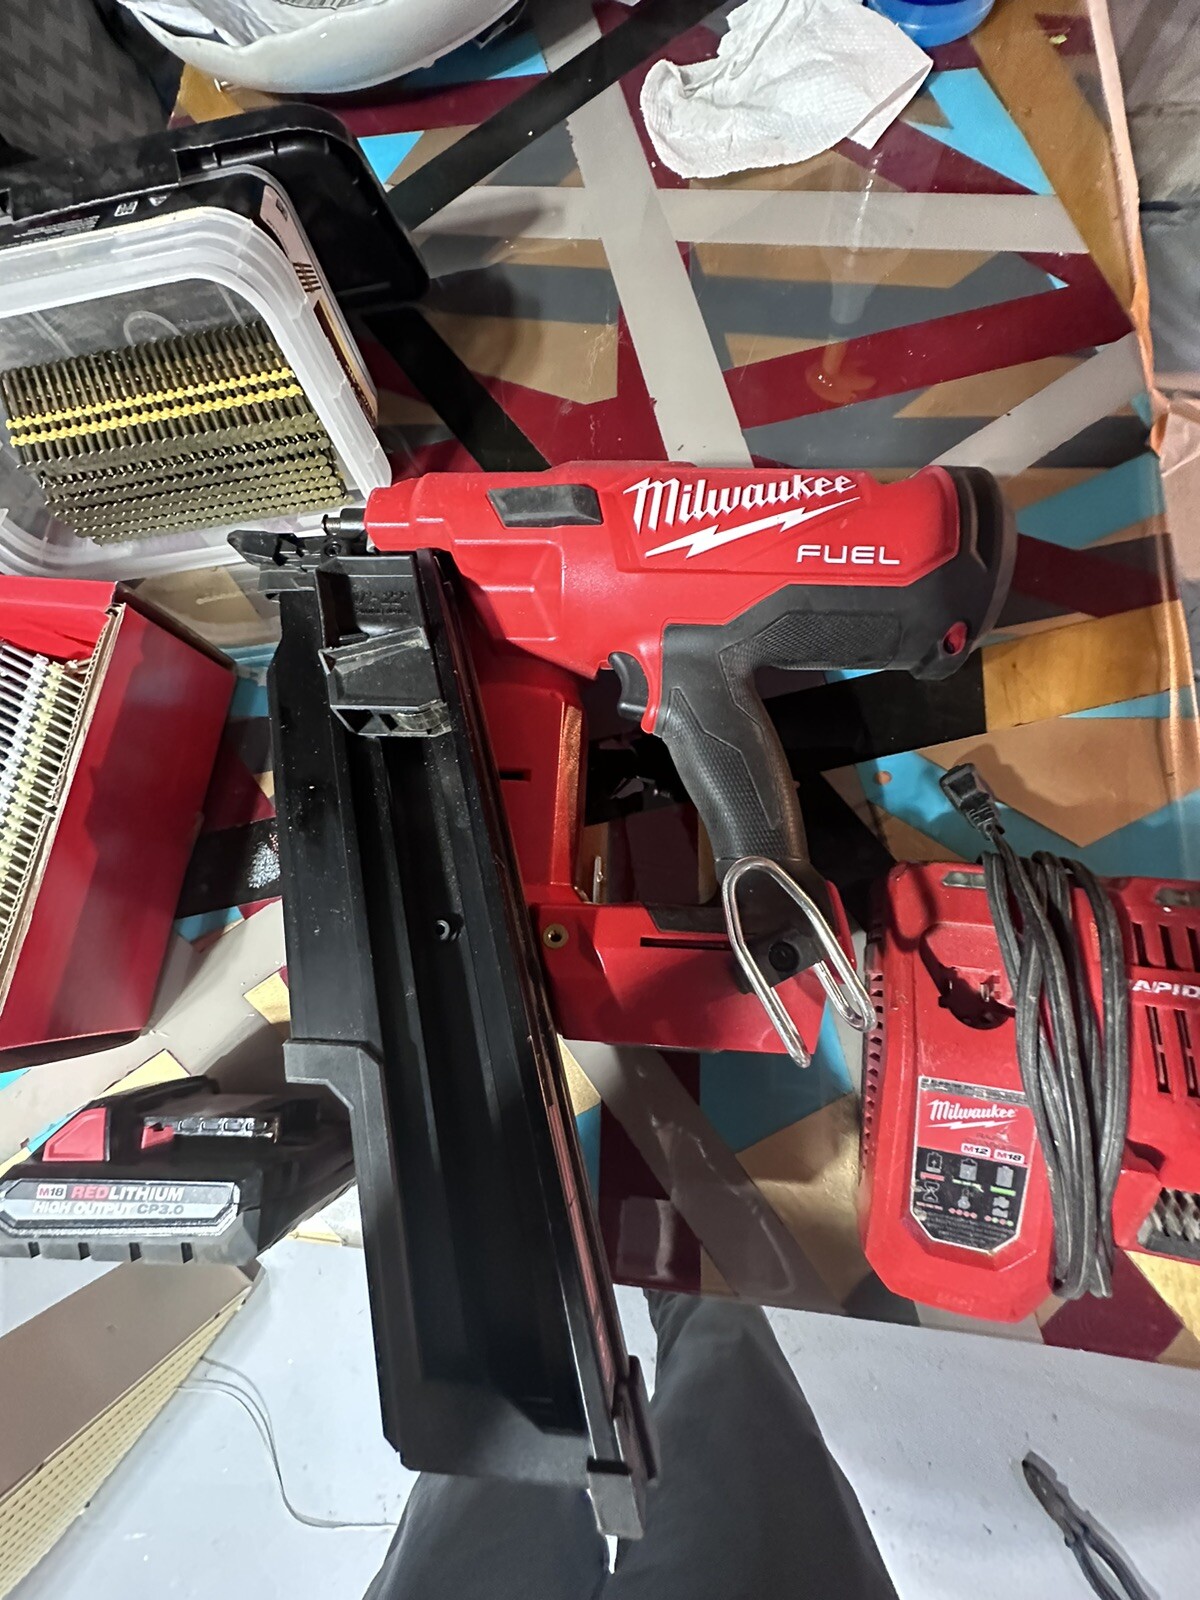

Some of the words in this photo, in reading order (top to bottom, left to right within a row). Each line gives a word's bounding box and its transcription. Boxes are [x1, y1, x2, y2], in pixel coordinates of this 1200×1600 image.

[623, 474, 857, 535] Milwaukee
[796, 544, 900, 565] FUEL
[1130, 979, 1200, 999] APID
[927, 1099, 1018, 1121] Milwaukee
[38, 1185, 64, 1198] M18
[71, 1184, 185, 1202] REDLITHIUM
[33, 1201, 71, 1214] HIGH
